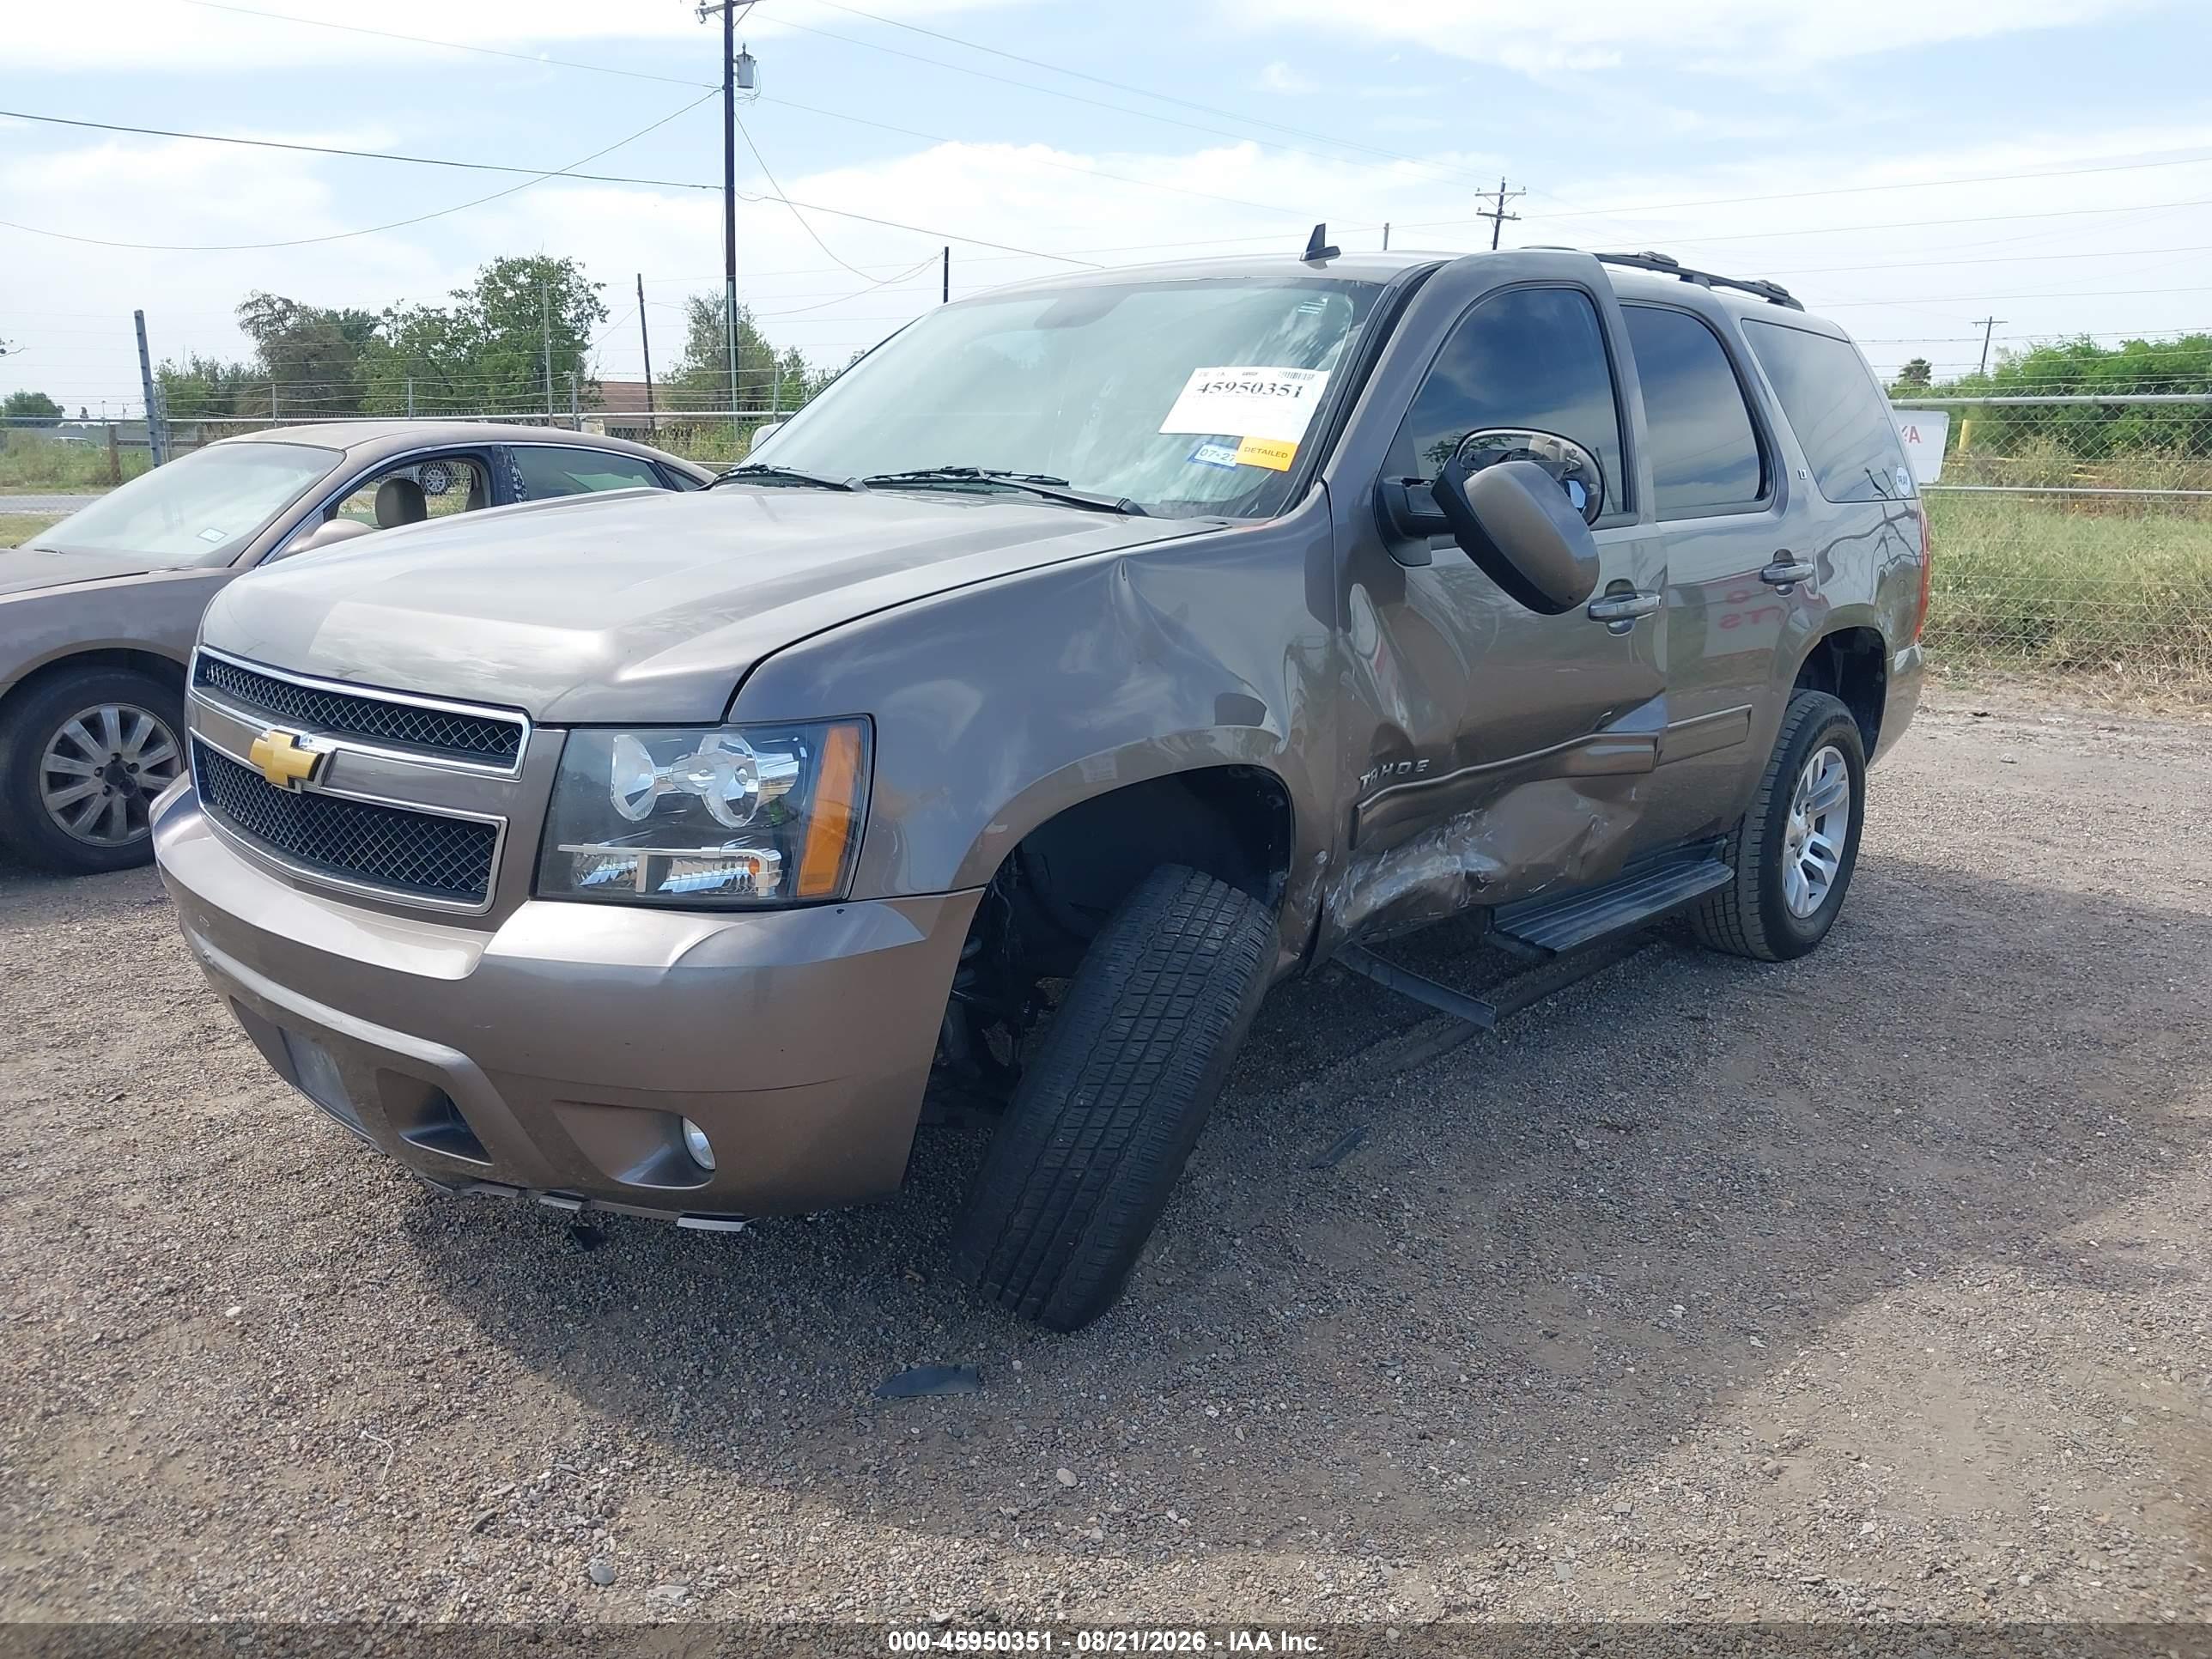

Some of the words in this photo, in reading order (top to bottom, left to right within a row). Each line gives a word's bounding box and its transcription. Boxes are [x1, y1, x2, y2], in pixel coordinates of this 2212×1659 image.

[1196, 381, 1304, 398] 45950351
[1243, 446, 1289, 459] DETAILED
[1358, 759, 1430, 790] TAHOE
